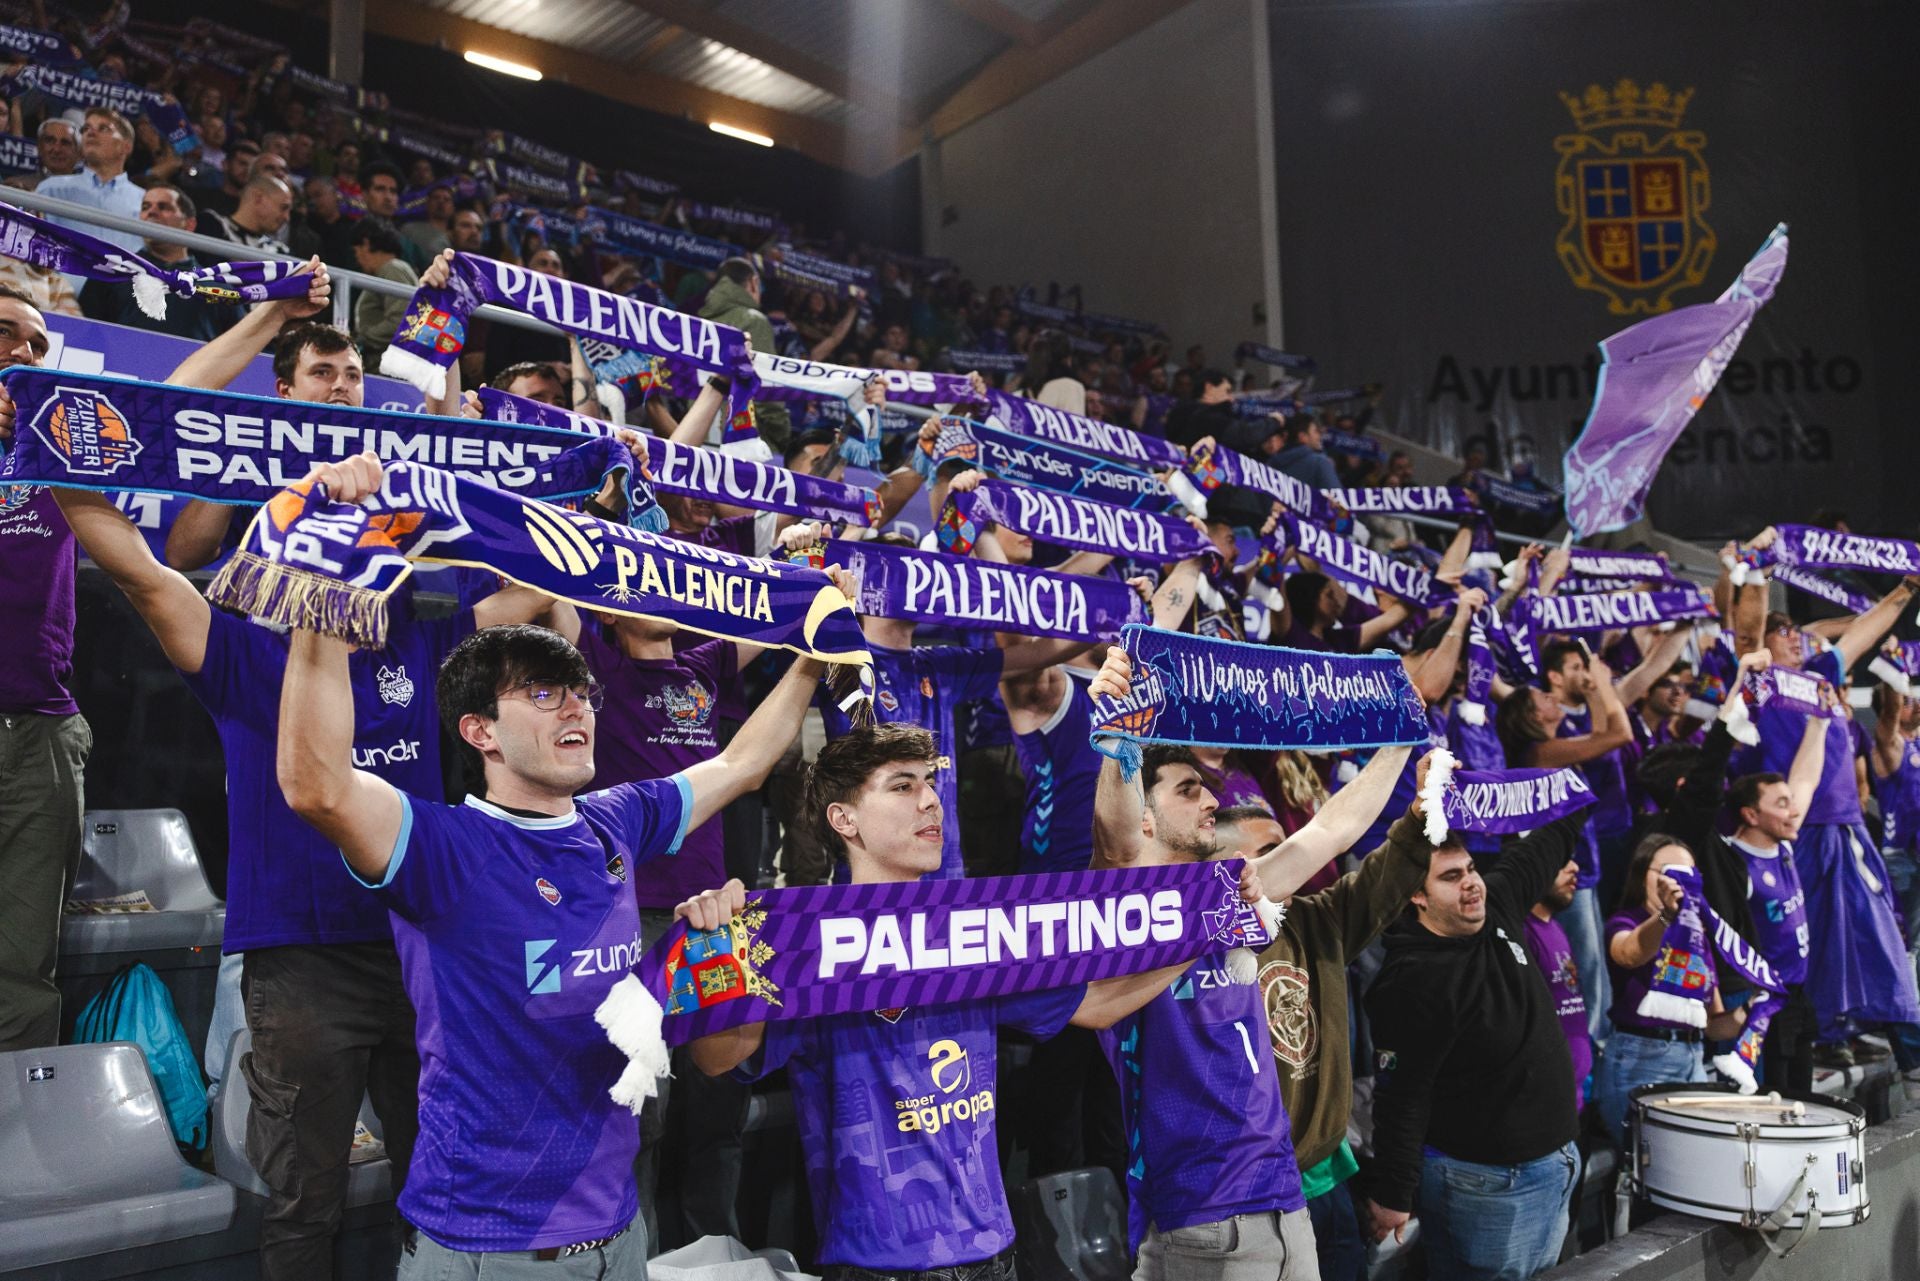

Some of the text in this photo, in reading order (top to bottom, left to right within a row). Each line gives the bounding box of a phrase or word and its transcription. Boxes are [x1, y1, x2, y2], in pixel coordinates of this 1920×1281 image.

[496, 262, 724, 366] PALENCIA
[65, 406, 83, 456] PALENCIA
[73, 396, 102, 467] ZUNDER
[983, 440, 1074, 478] zunder
[1024, 401, 1149, 461] PALENCIA
[1238, 453, 1312, 517] PALENCIA
[1011, 486, 1168, 556] PALENCIA
[1801, 529, 1918, 572] PALENCIA
[613, 542, 776, 624] PALENCIA
[899, 555, 1089, 635] PALENCIA
[1297, 519, 1431, 604] PALENCIA
[1272, 664, 1300, 698] mi
[1301, 659, 1398, 711] Palencia!!
[817, 889, 1183, 980] PALENTINOS
